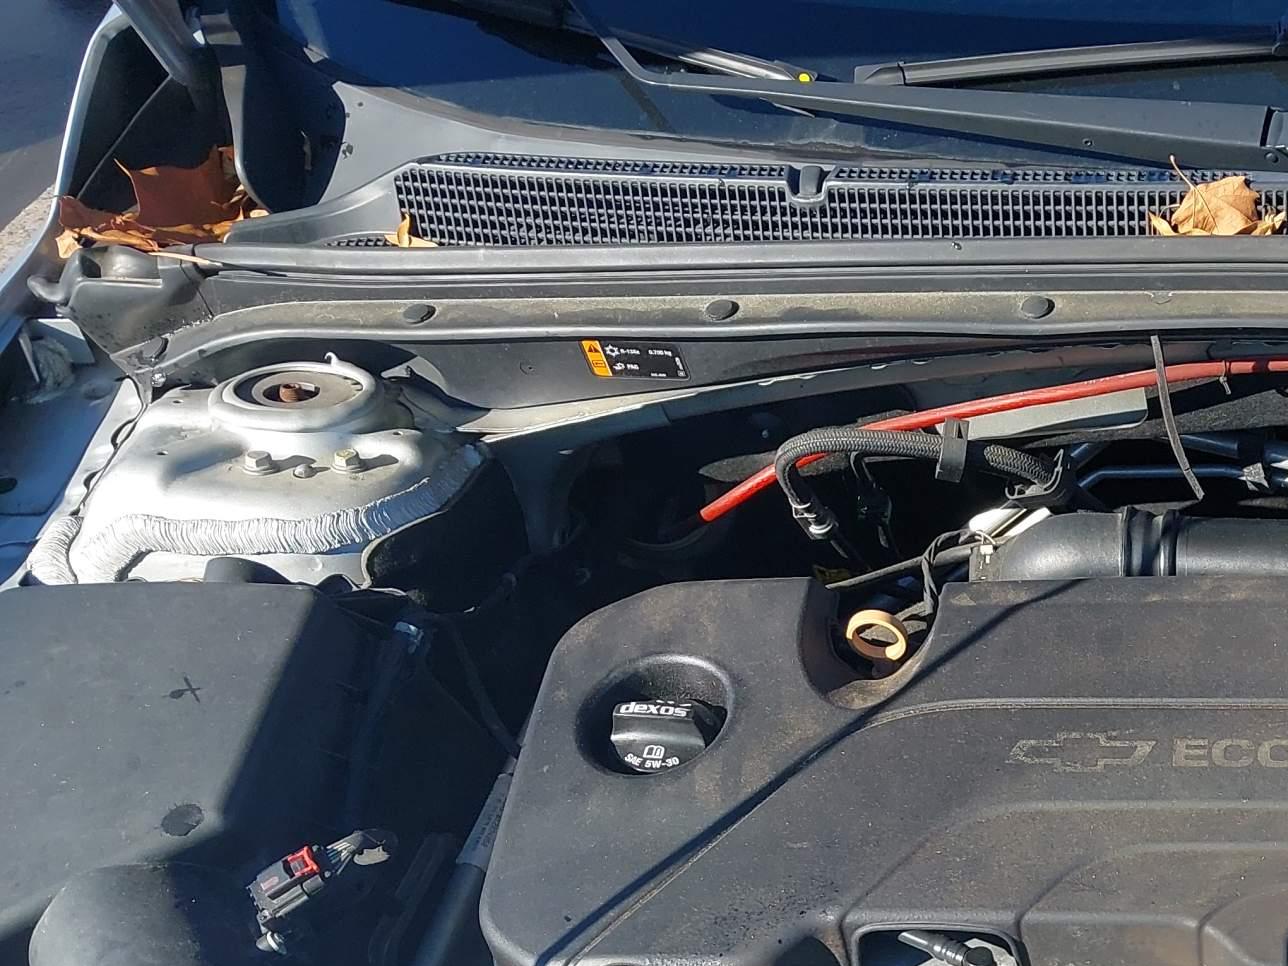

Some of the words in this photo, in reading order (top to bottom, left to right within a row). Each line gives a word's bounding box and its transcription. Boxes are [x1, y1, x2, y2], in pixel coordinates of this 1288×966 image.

[620, 701, 692, 717] dexos
[624, 753, 643, 766] SAE
[644, 756, 680, 769] 5W-30
